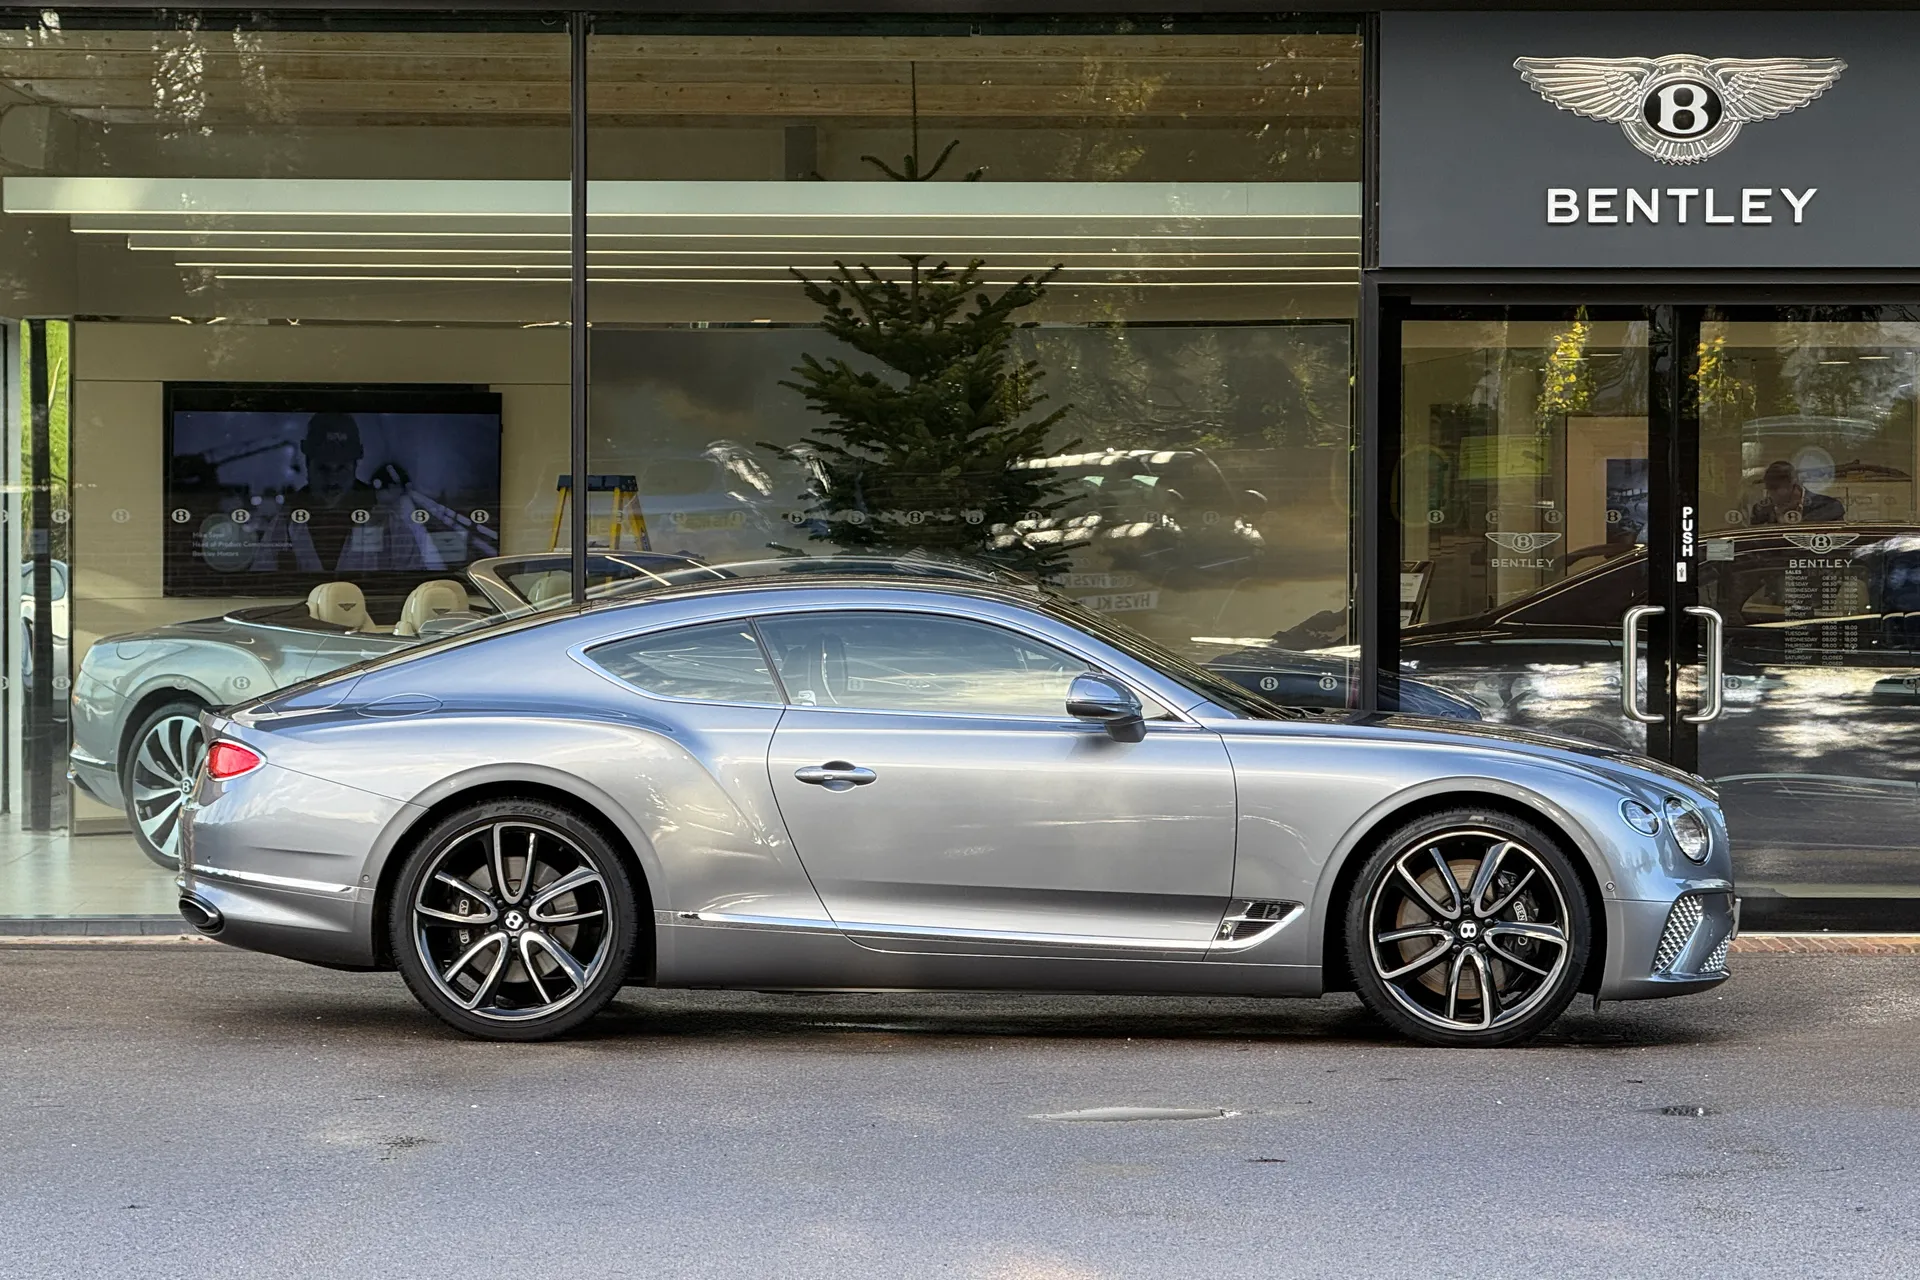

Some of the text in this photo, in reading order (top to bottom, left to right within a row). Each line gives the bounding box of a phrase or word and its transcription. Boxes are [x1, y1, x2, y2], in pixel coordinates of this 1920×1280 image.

[1656, 86, 1709, 135] B
[1547, 188, 1818, 224] BENTLEY
[1682, 506, 1694, 557] PUSH
[1516, 535, 1530, 549] B
[1814, 535, 1829, 548] B
[1491, 558, 1555, 568] BENTLEY
[1789, 559, 1853, 568] BENTLEY
[1262, 904, 1281, 919] 12
[505, 911, 523, 930] B
